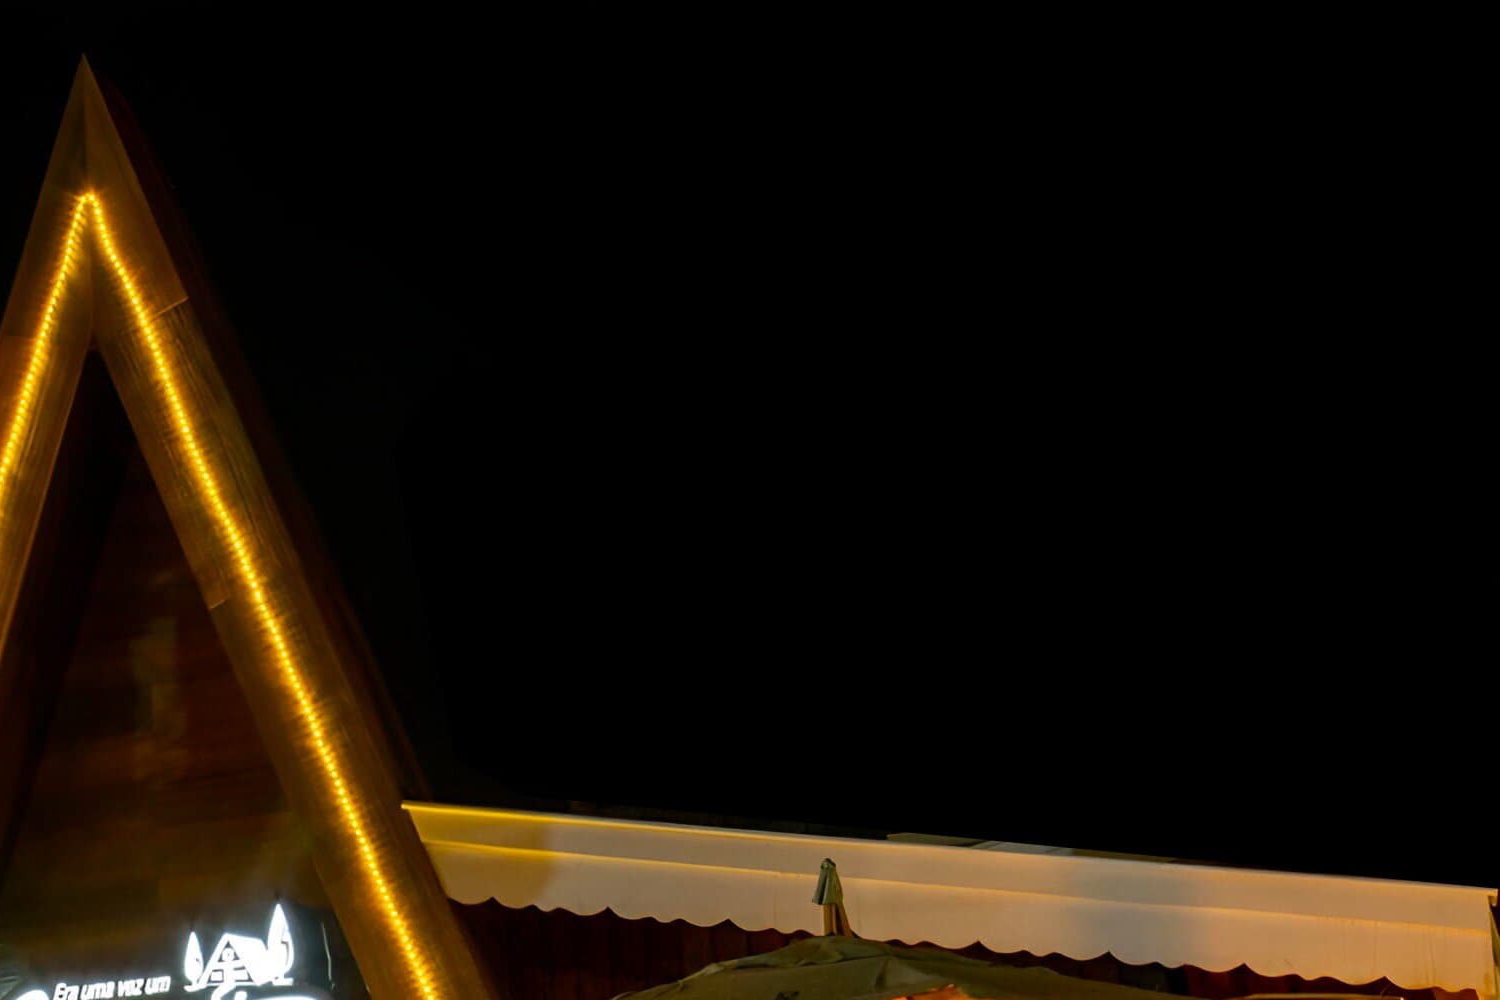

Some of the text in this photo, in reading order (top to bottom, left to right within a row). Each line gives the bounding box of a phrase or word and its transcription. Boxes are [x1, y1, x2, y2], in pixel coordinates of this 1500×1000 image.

[81, 981, 115, 1000] uma
[117, 979, 145, 997] vez
[145, 976, 171, 995] um
